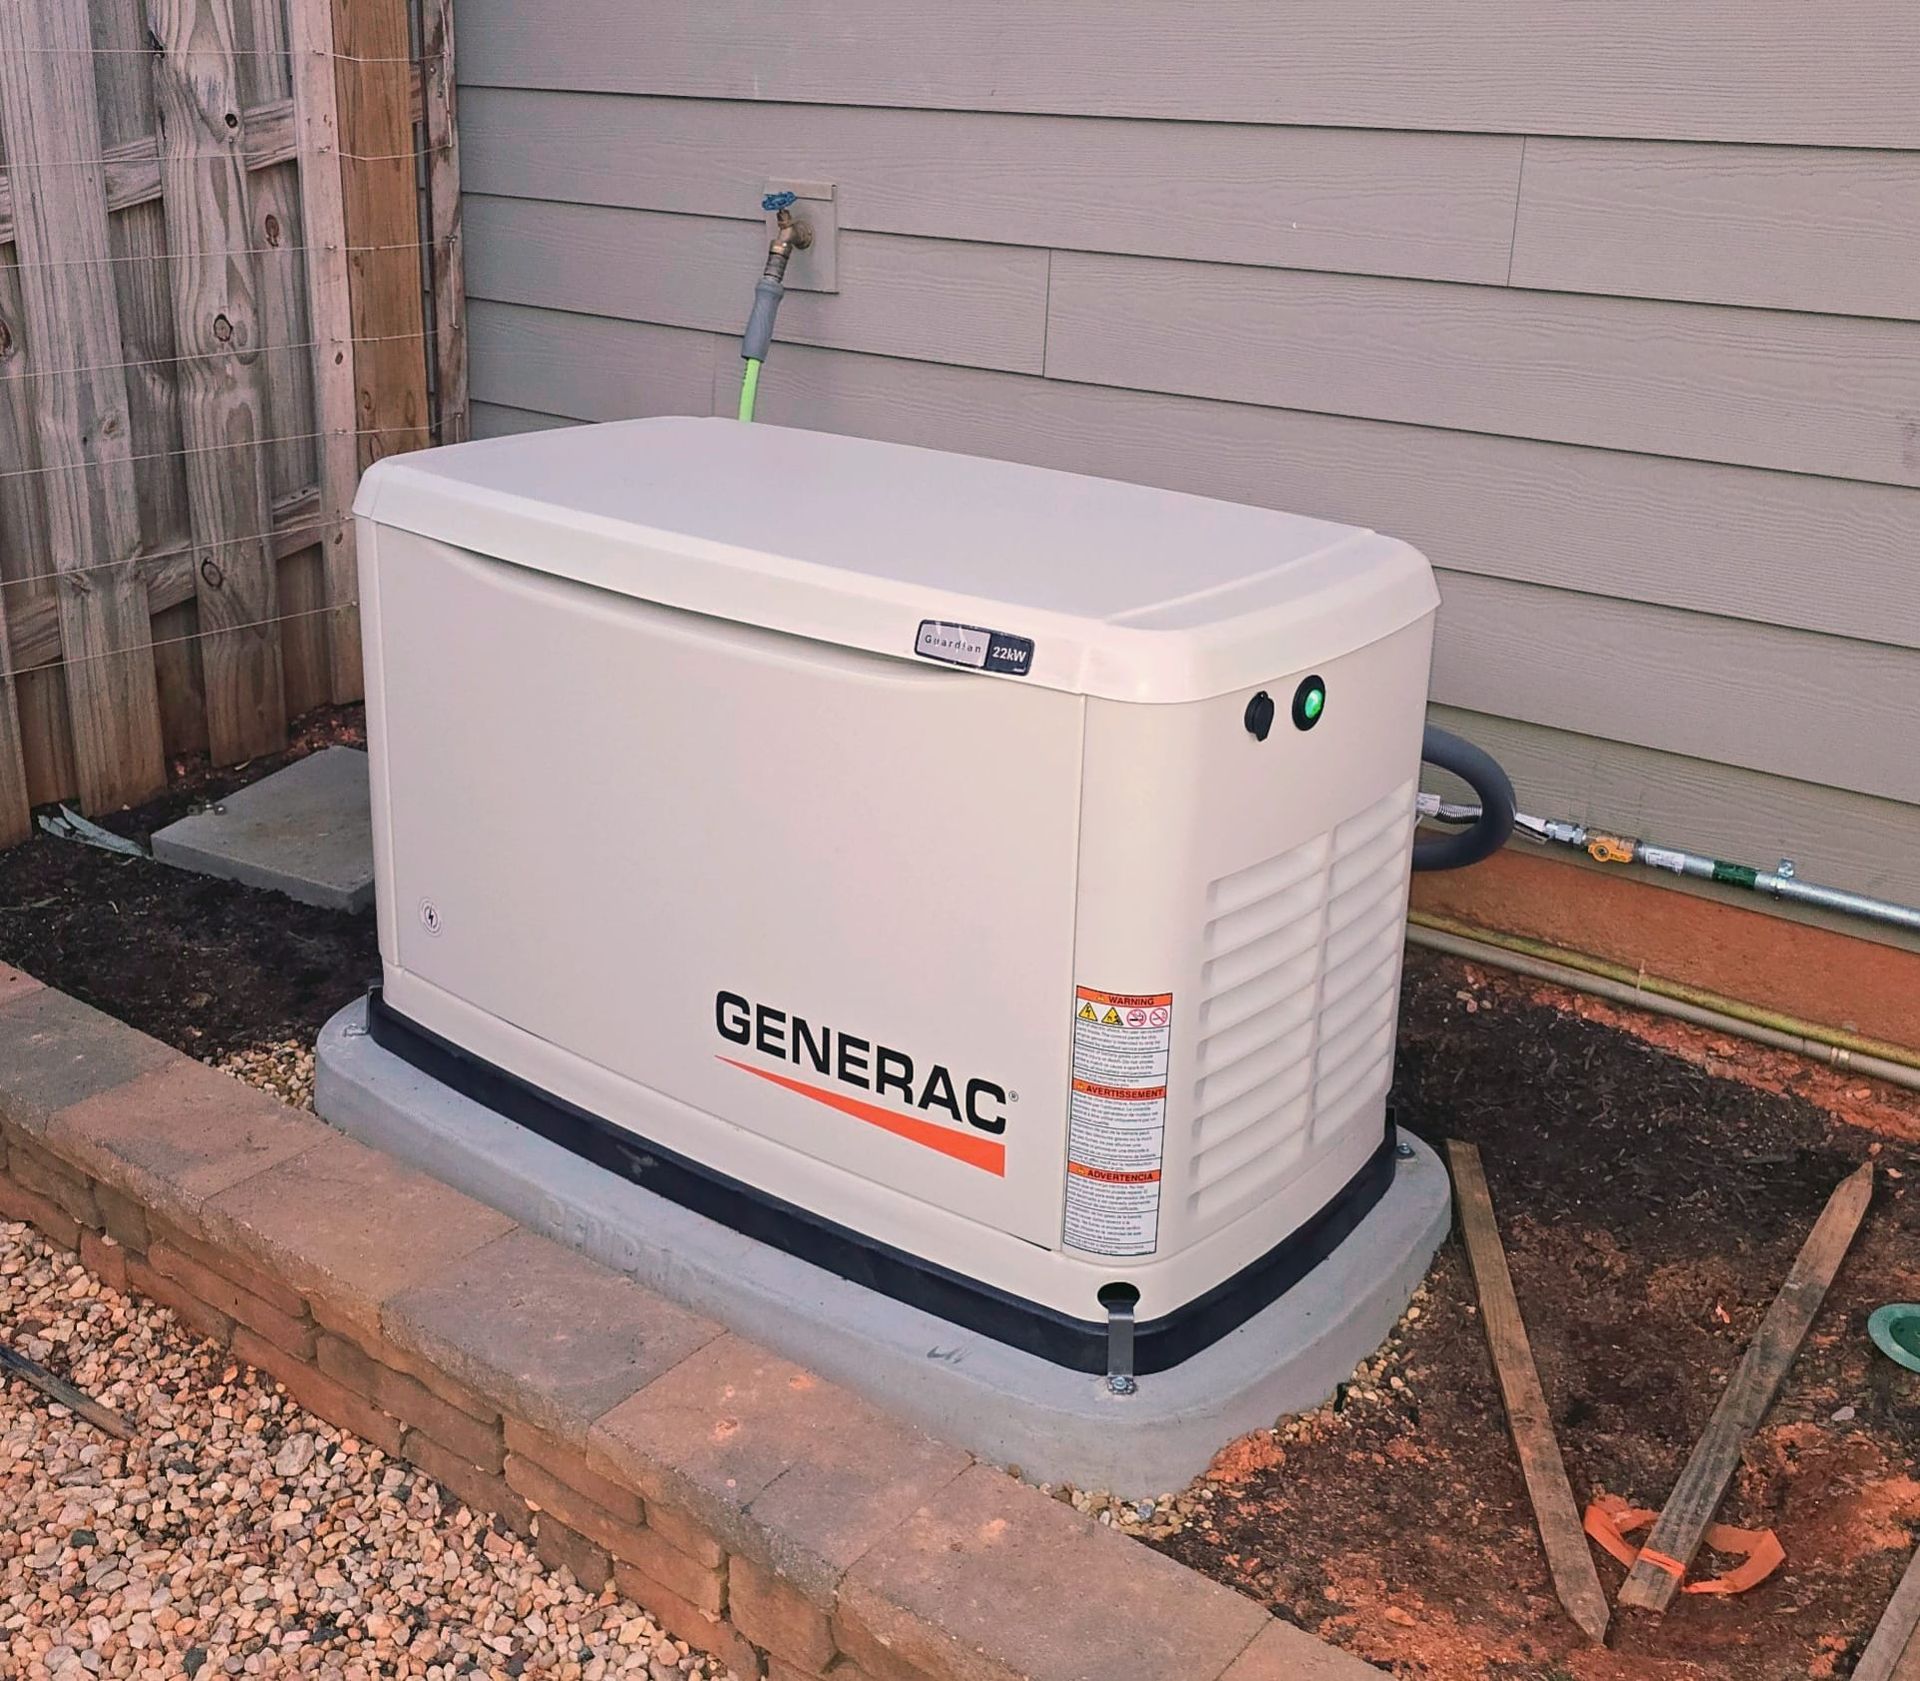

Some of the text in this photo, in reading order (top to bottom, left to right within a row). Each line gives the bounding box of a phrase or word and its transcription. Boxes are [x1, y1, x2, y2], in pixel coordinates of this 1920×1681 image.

[924, 634, 1027, 663] Guardian 22kW
[1108, 995, 1155, 1006] WARNING
[716, 990, 1007, 1135] GENERAC
[1086, 1085, 1164, 1099] AVERTISSEMENT
[1087, 1169, 1154, 1182] ADVERTENCIA
